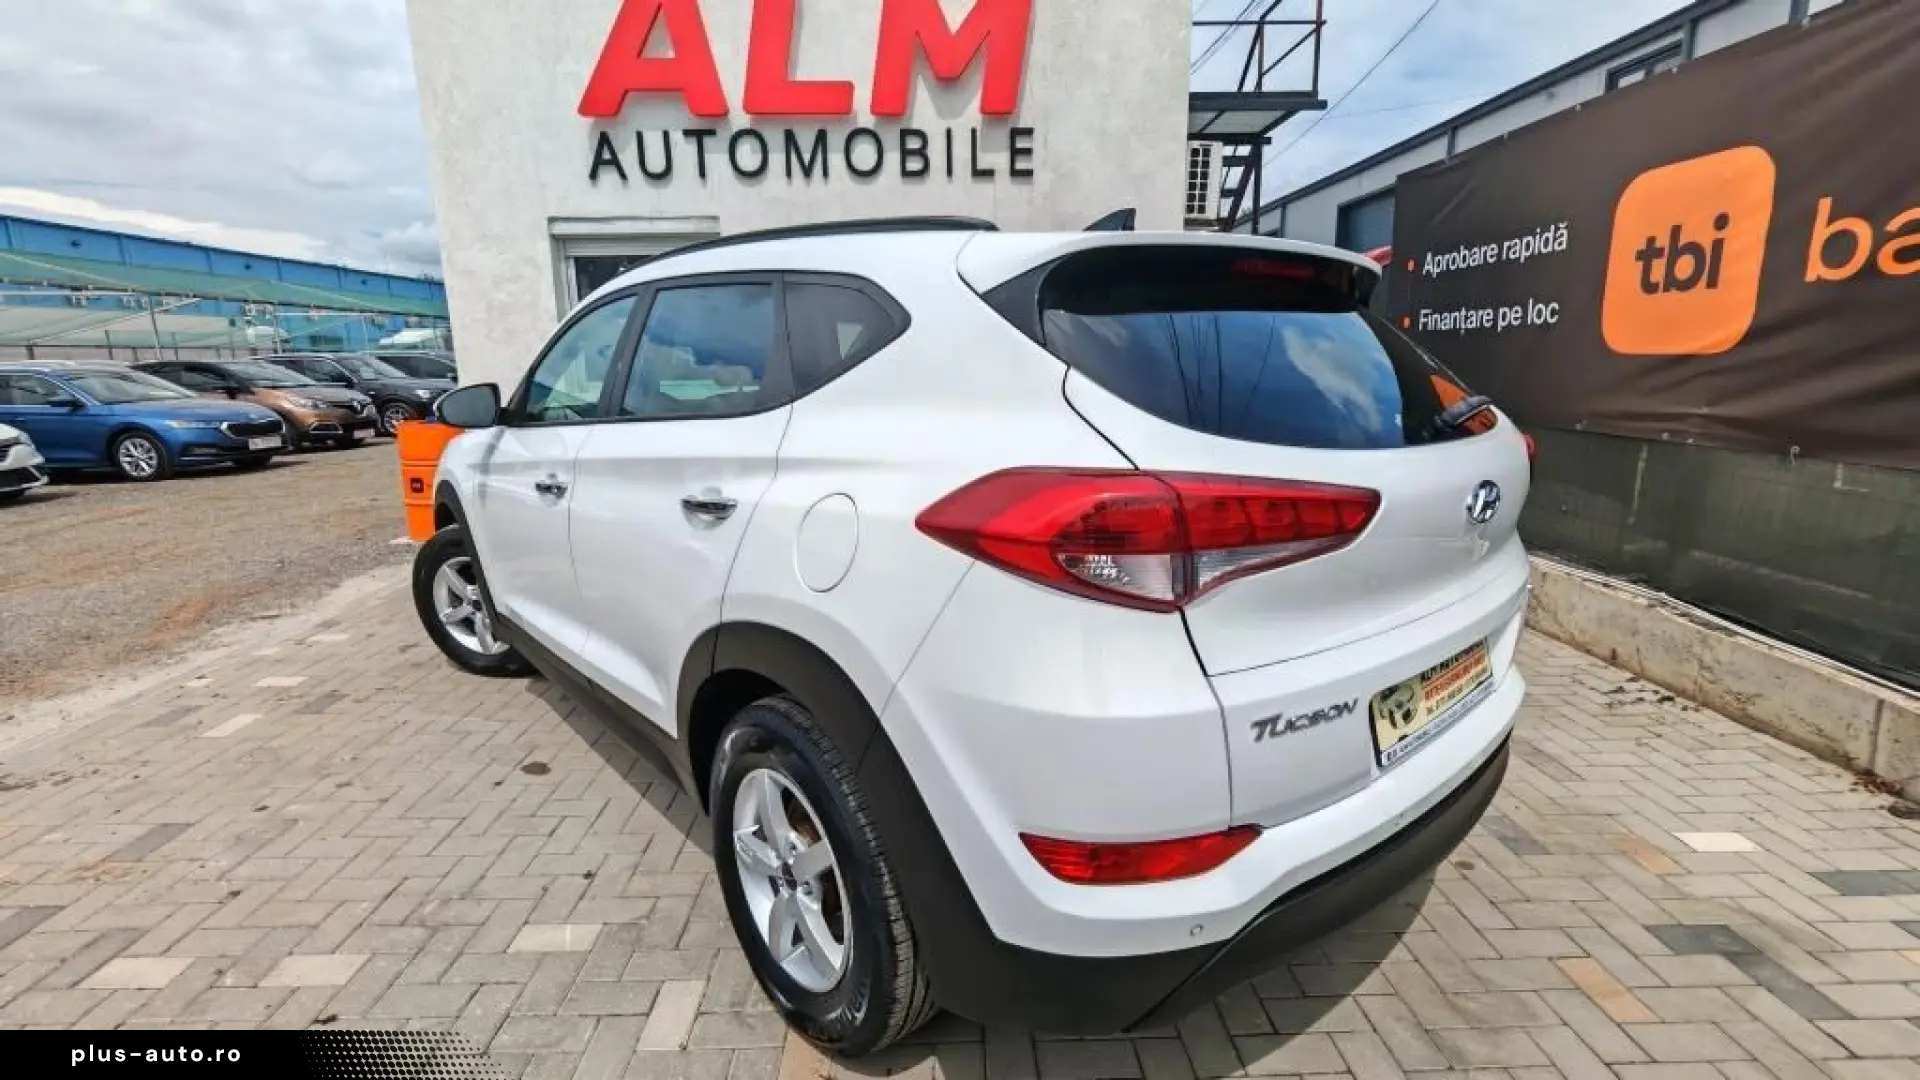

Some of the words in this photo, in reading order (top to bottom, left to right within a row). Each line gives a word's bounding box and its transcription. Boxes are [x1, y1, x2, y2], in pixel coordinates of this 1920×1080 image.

[578, 0, 1031, 116] ALM
[589, 127, 1034, 180] AUTOMOBILE
[1423, 244, 1499, 278] Aprobare
[1502, 221, 1568, 263] rapidă
[1635, 211, 1729, 295] tbi
[1418, 306, 1494, 335] Finanțare
[1497, 304, 1522, 332] pe
[1527, 298, 1559, 325] loc
